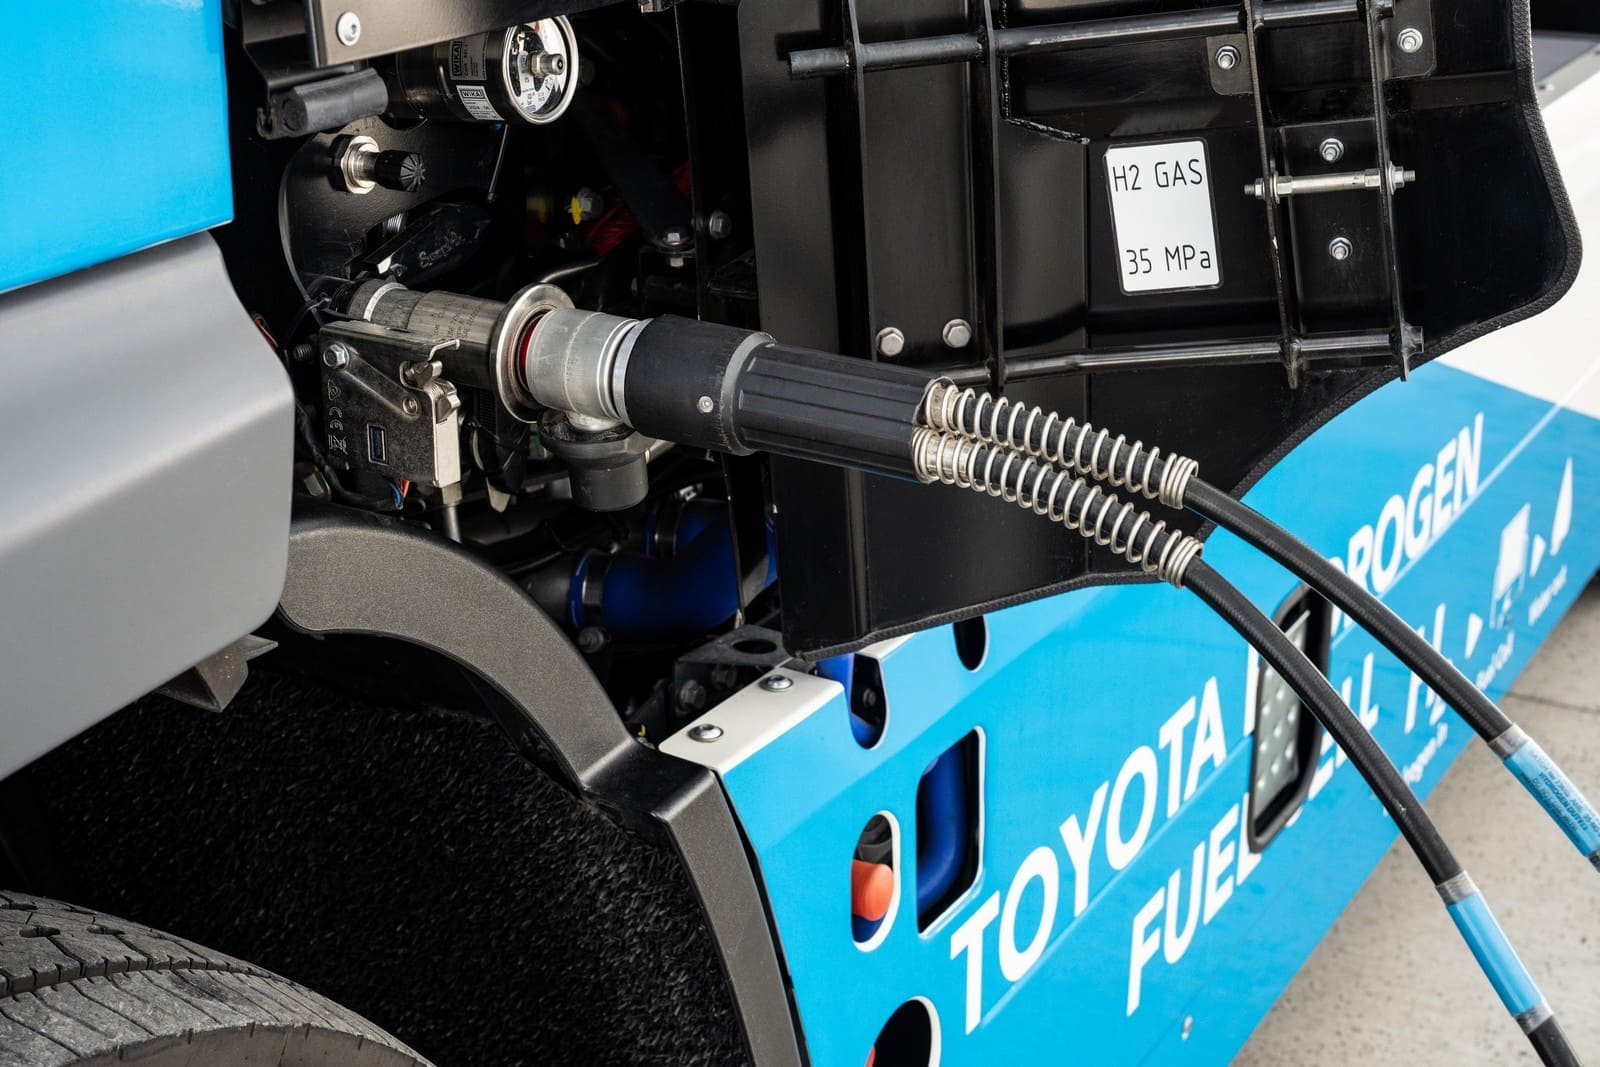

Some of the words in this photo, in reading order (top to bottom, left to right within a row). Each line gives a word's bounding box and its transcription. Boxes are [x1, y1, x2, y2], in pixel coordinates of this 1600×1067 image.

[453, 45, 461, 75] WIKA
[461, 89, 483, 98] WIKA
[1112, 164, 1142, 192] H2
[1154, 158, 1203, 188] GAS
[1126, 248, 1152, 275] 35
[1164, 244, 1211, 272] MPa
[951, 676, 1227, 1036] TOYOTA
[1126, 792, 1262, 1017] FUEL
